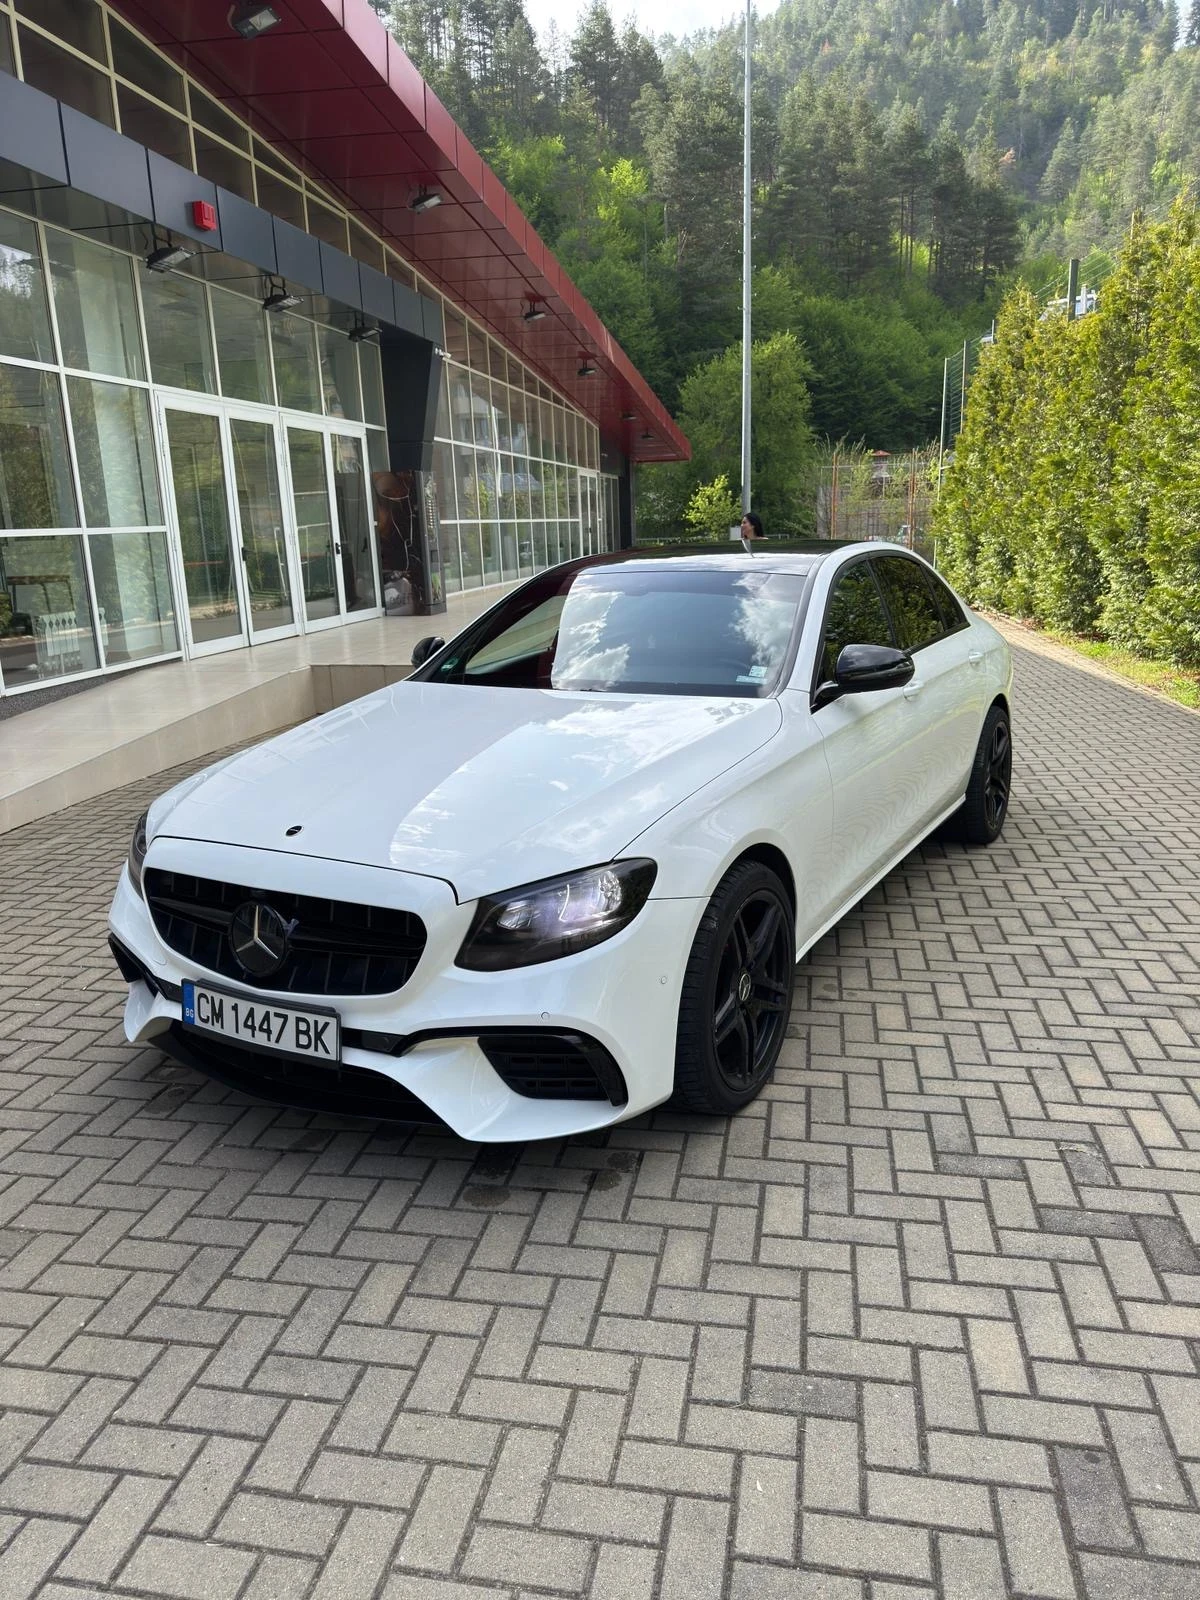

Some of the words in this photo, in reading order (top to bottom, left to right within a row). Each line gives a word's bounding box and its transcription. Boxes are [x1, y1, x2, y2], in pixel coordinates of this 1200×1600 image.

[185, 1007, 194, 1018] BG
[197, 992, 224, 1030] CM
[231, 1002, 289, 1044] 1447
[295, 1015, 331, 1055] BK
